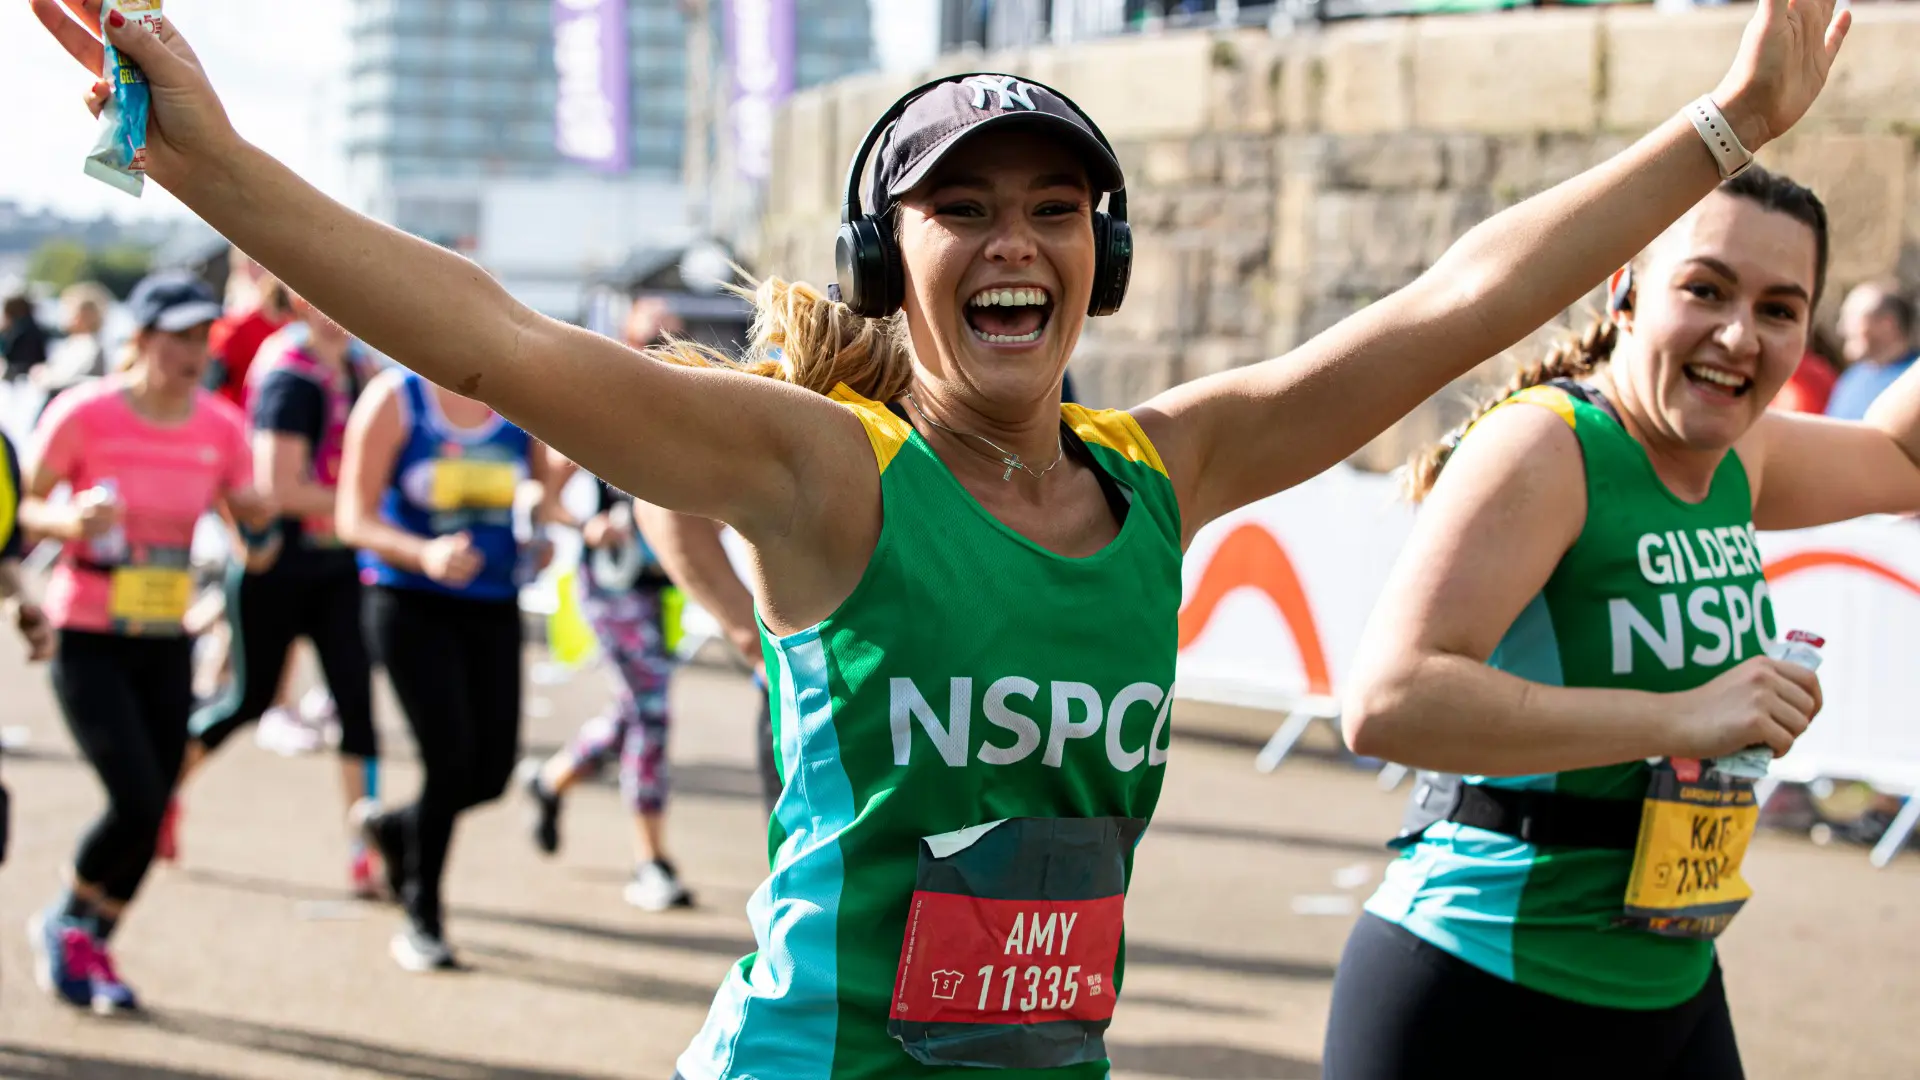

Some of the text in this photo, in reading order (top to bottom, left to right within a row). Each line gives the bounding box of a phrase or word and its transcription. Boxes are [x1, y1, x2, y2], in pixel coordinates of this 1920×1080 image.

[119, 69, 134, 84] GEL
[1004, 912, 1077, 955] AMY
[977, 964, 1081, 1012] 11335
